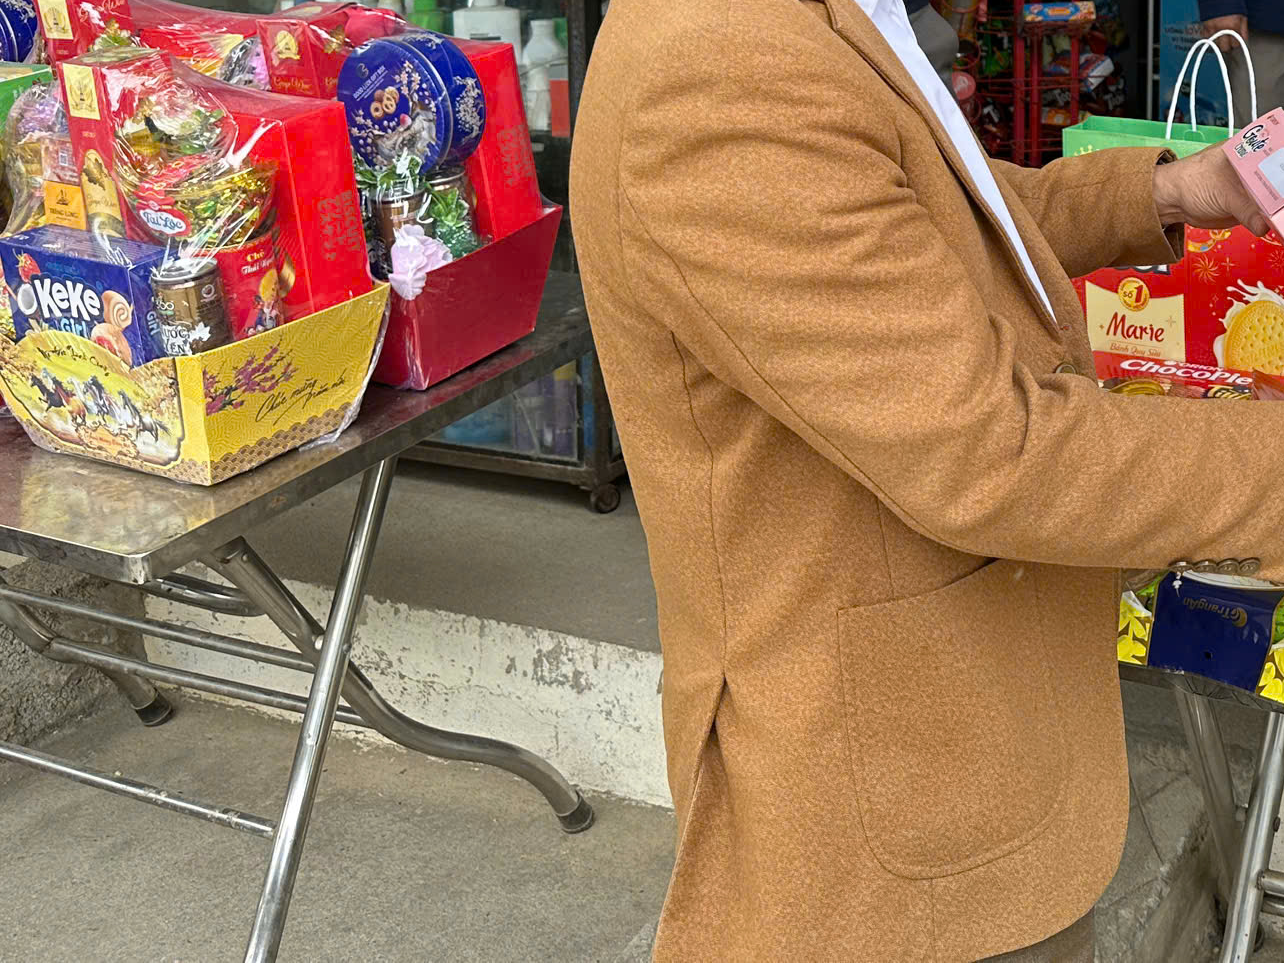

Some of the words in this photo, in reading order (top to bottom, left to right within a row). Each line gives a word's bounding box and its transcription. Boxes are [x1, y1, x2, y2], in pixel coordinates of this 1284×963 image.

[1106, 312, 1165, 343] Marie
[1110, 343, 1129, 353] Bánh
[1131, 347, 1146, 358] Quy
